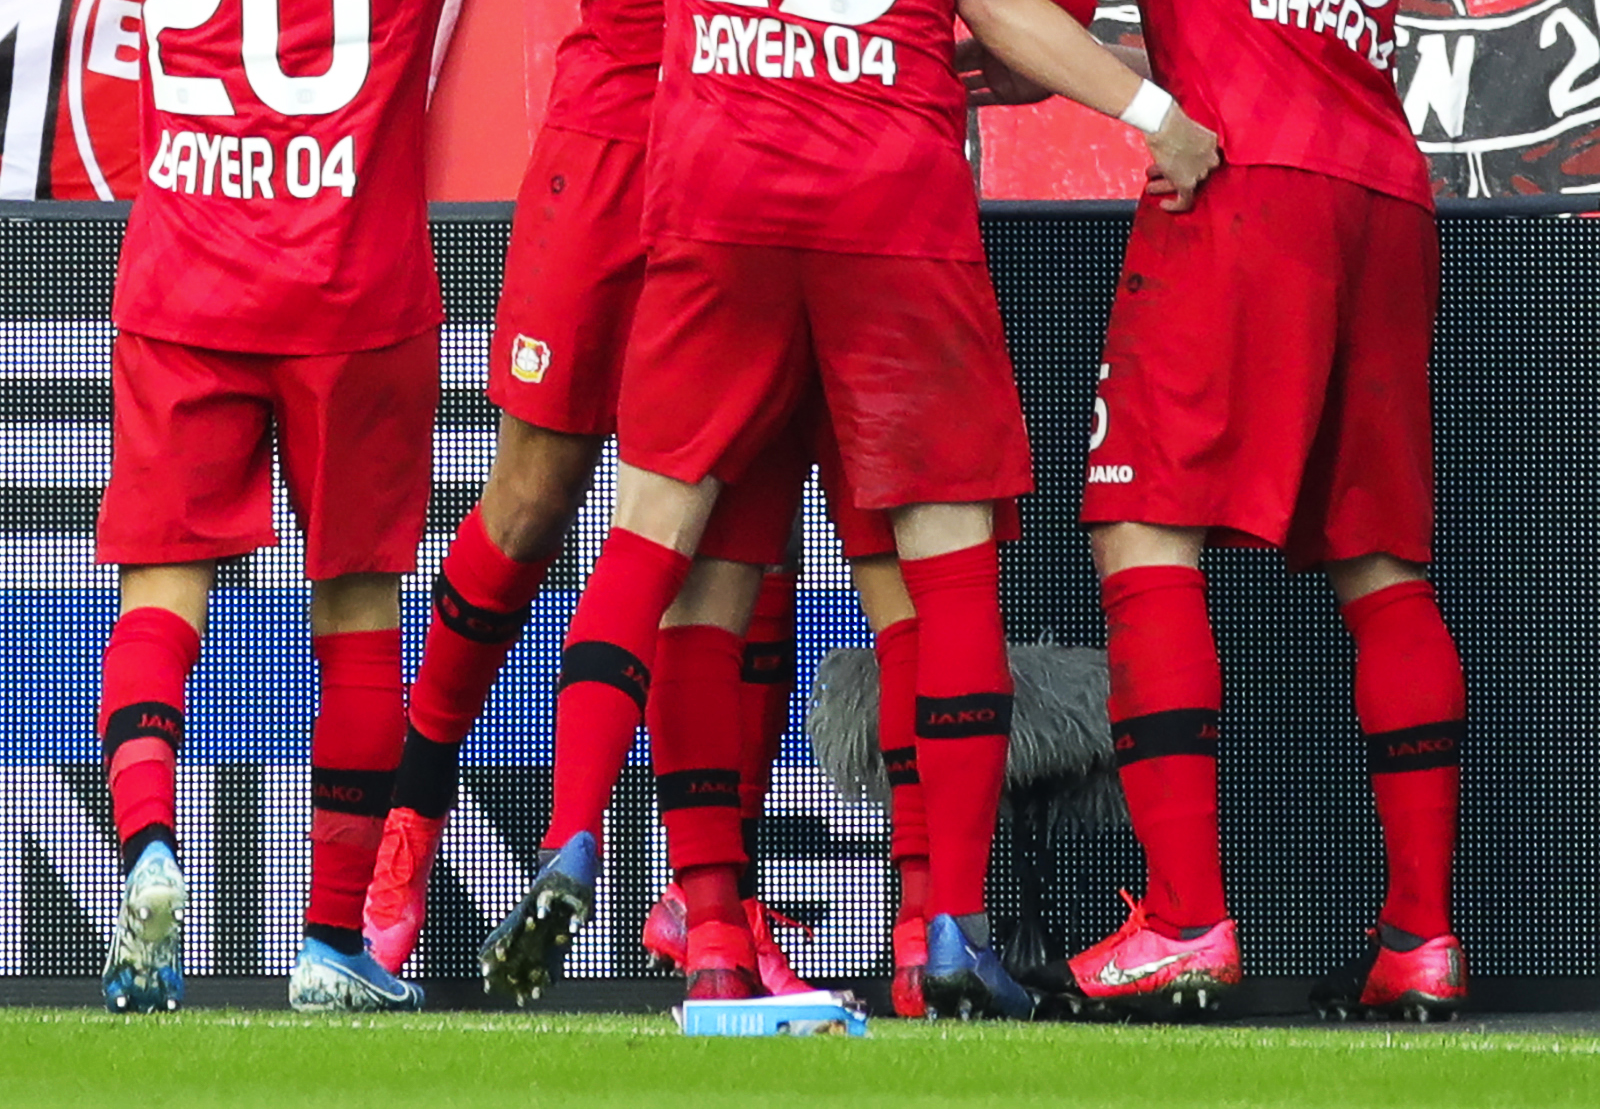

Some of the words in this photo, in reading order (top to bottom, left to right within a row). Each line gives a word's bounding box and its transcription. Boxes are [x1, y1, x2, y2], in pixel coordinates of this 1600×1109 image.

[691, 14, 816, 78] BAYER
[824, 25, 896, 86] 04
[149, 130, 275, 200] BAYER
[286, 135, 357, 198] 04
[1088, 464, 1134, 483] JAKO
[928, 707, 997, 726] JAKO
[314, 783, 364, 802] AKO
